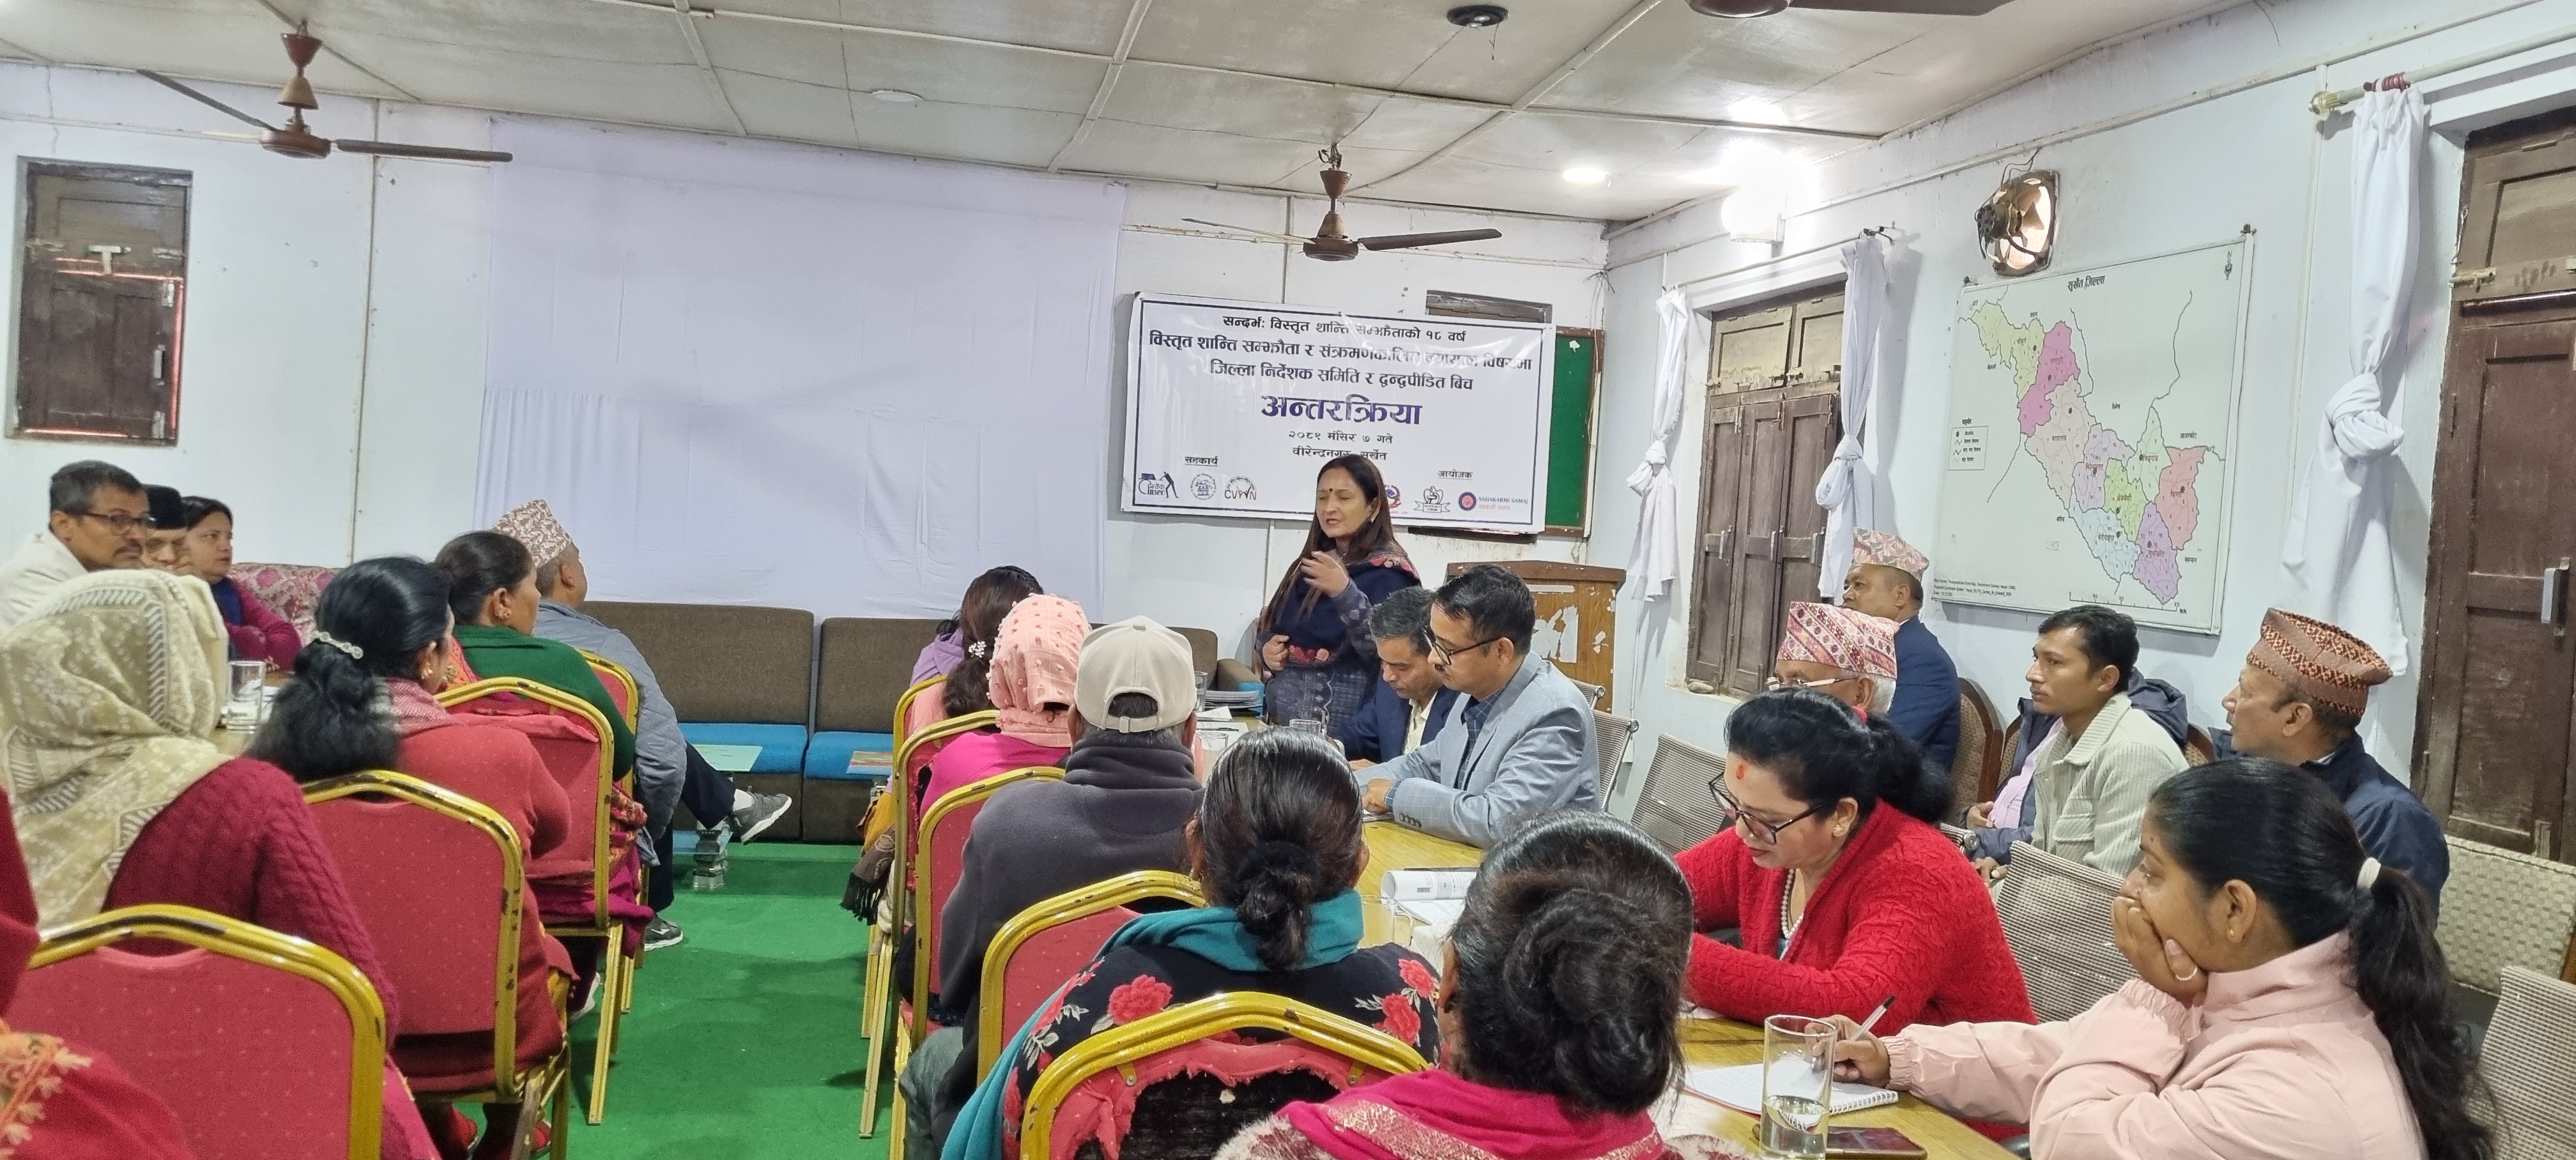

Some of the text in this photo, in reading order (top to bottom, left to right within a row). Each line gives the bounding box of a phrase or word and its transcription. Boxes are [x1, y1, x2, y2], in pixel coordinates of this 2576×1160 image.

[2085, 275, 2105, 288] जिल्ला
[1270, 317, 1310, 334] विस्तृत
[1316, 321, 1349, 334] शान्ति
[1426, 331, 1441, 340] १८
[1448, 331, 1466, 342] वर्ष
[1150, 330, 1193, 351] विस्तृत
[1198, 335, 1238, 351] शान्ति
[1305, 344, 1315, 356] र
[1211, 359, 1255, 376] जिल्ला
[1261, 362, 1313, 380] निर्देशक
[1317, 366, 1360, 383] समिति
[1365, 372, 1375, 385] र
[1450, 374, 1473, 390] बिच
[1261, 393, 1423, 425] अन्तरक्रिया
[1328, 431, 1357, 442] मंसिर
[1377, 432, 1393, 444] गते
[1185, 456, 1218, 465] सहकार्य
[1438, 469, 1473, 478] आयोजक
